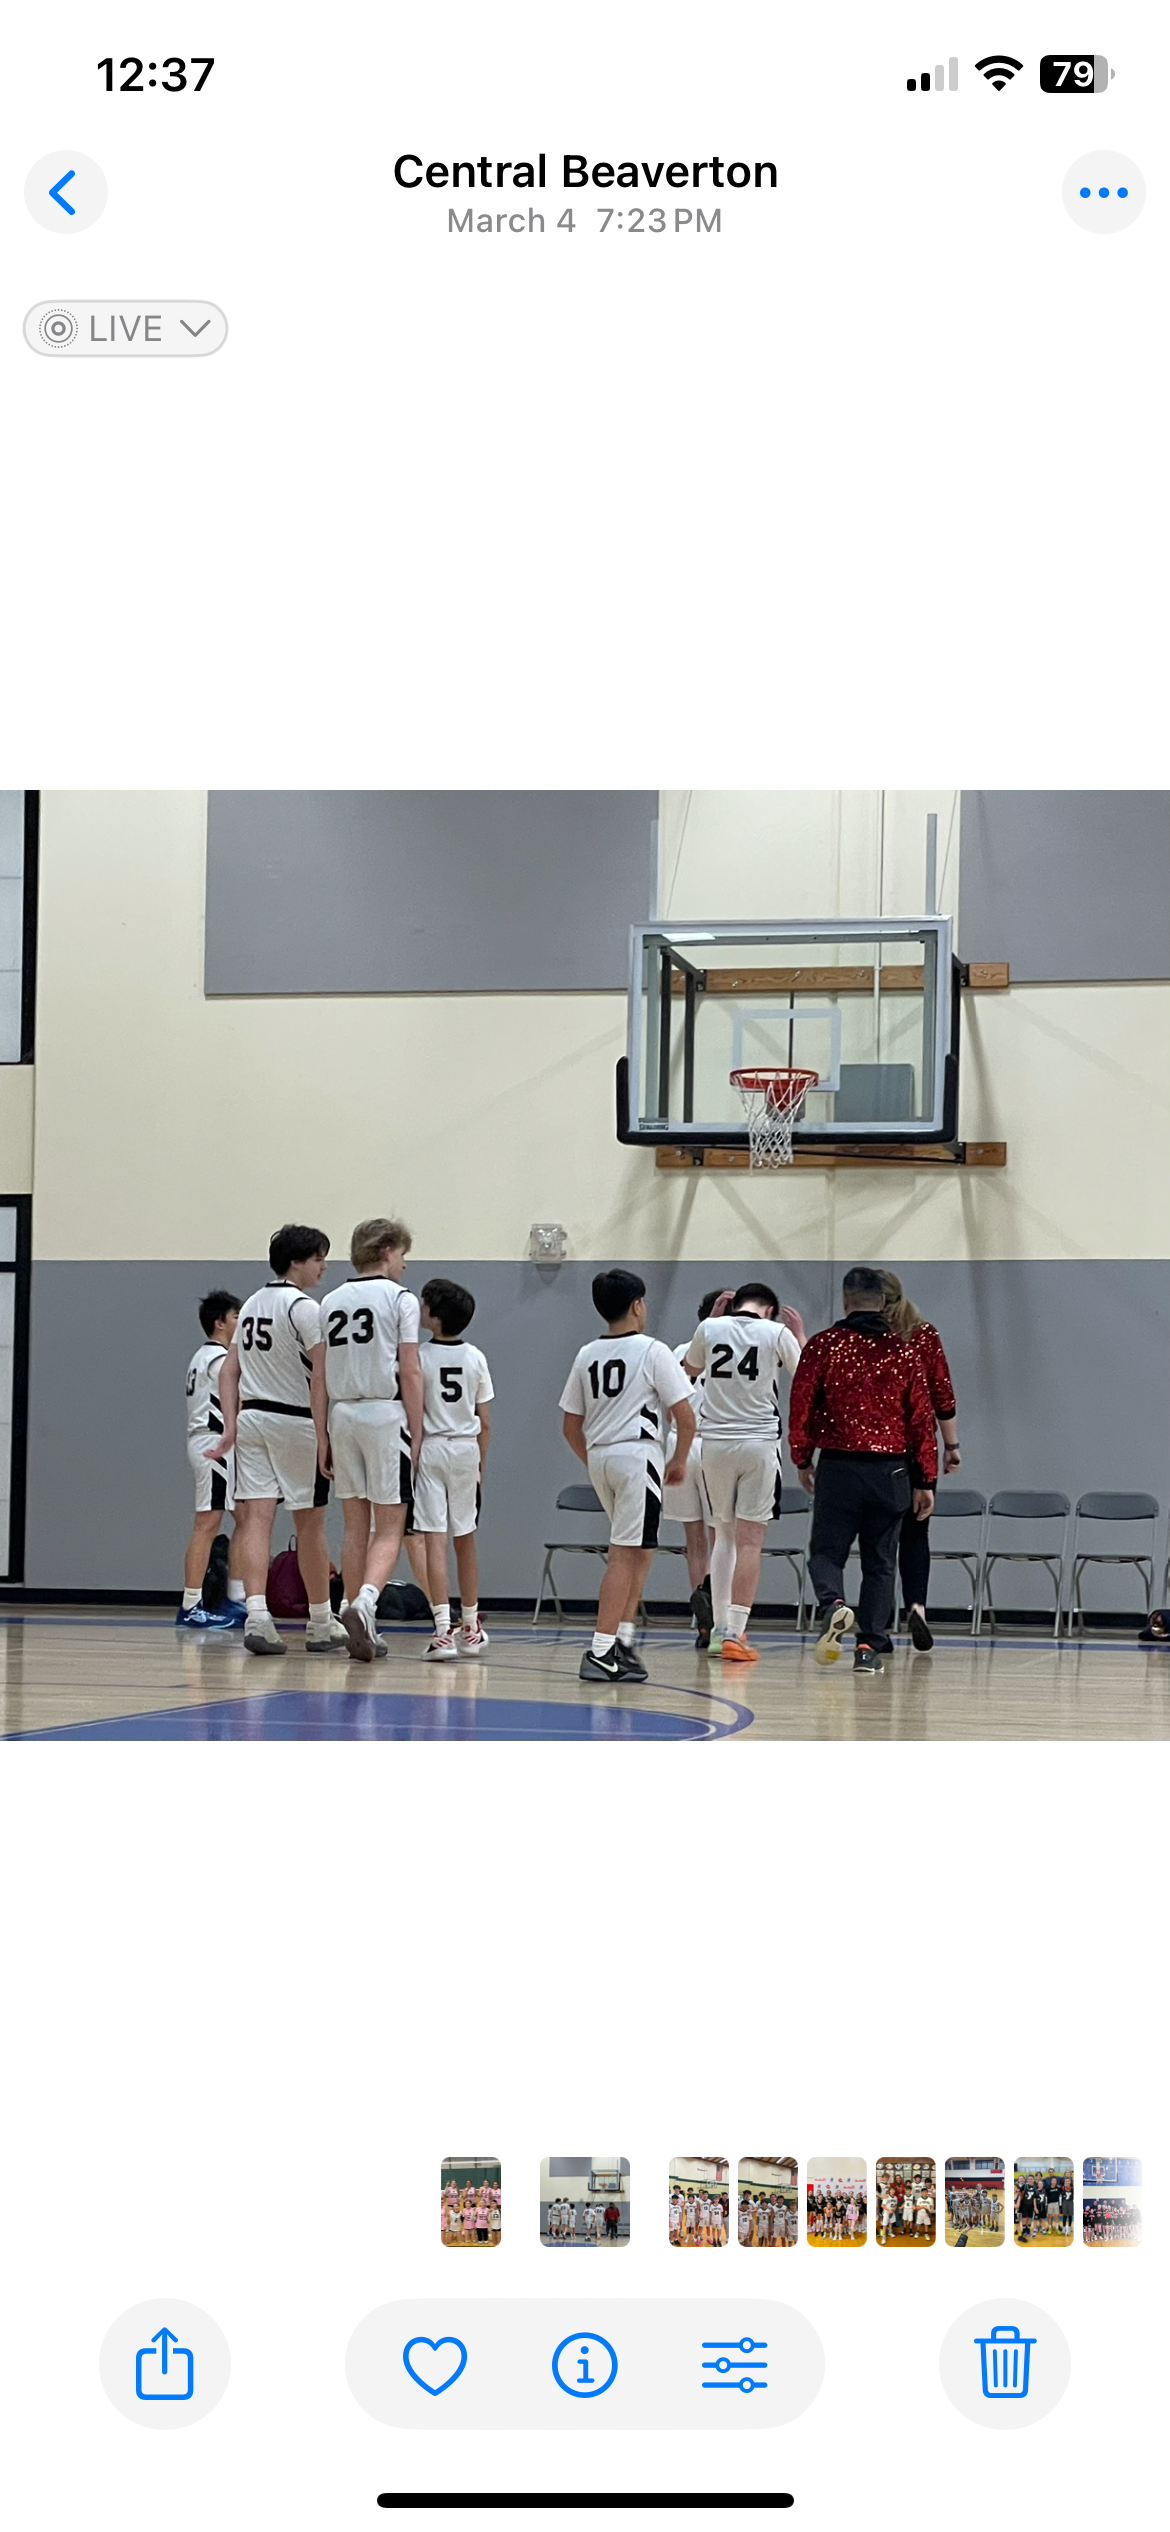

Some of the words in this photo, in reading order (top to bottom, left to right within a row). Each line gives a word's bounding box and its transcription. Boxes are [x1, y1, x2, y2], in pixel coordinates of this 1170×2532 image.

[97, 56, 215, 93] 12:37
[1052, 61, 1094, 88] 79
[393, 152, 546, 189] Central
[563, 153, 778, 189] Beaverton
[448, 206, 545, 233] March
[556, 208, 577, 233] 4
[90, 315, 162, 342] LIVE
[241, 1316, 273, 1351] 35
[327, 1307, 374, 1347] 23
[587, 1358, 627, 1400] 10
[710, 1343, 760, 1382] 24
[439, 1366, 464, 1403] 5
